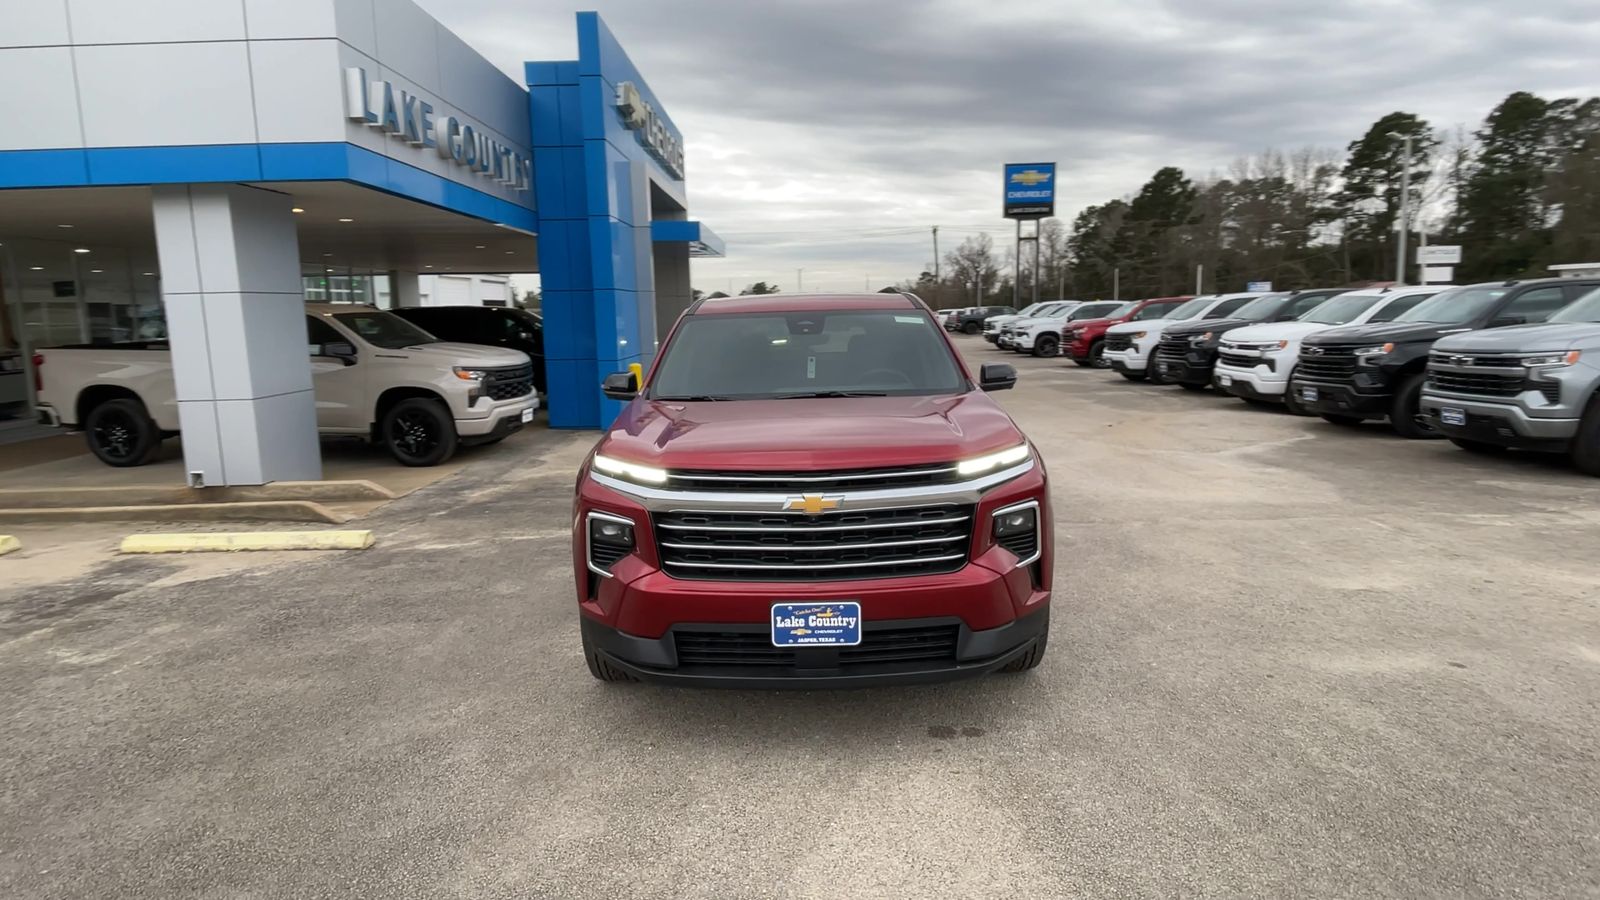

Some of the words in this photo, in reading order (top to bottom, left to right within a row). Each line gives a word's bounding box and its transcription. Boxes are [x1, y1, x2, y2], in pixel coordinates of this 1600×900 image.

[345, 67, 435, 149] LAKE
[437, 116, 530, 190] COUNTRY
[776, 616, 805, 627] Lake
[808, 615, 856, 628] Country
